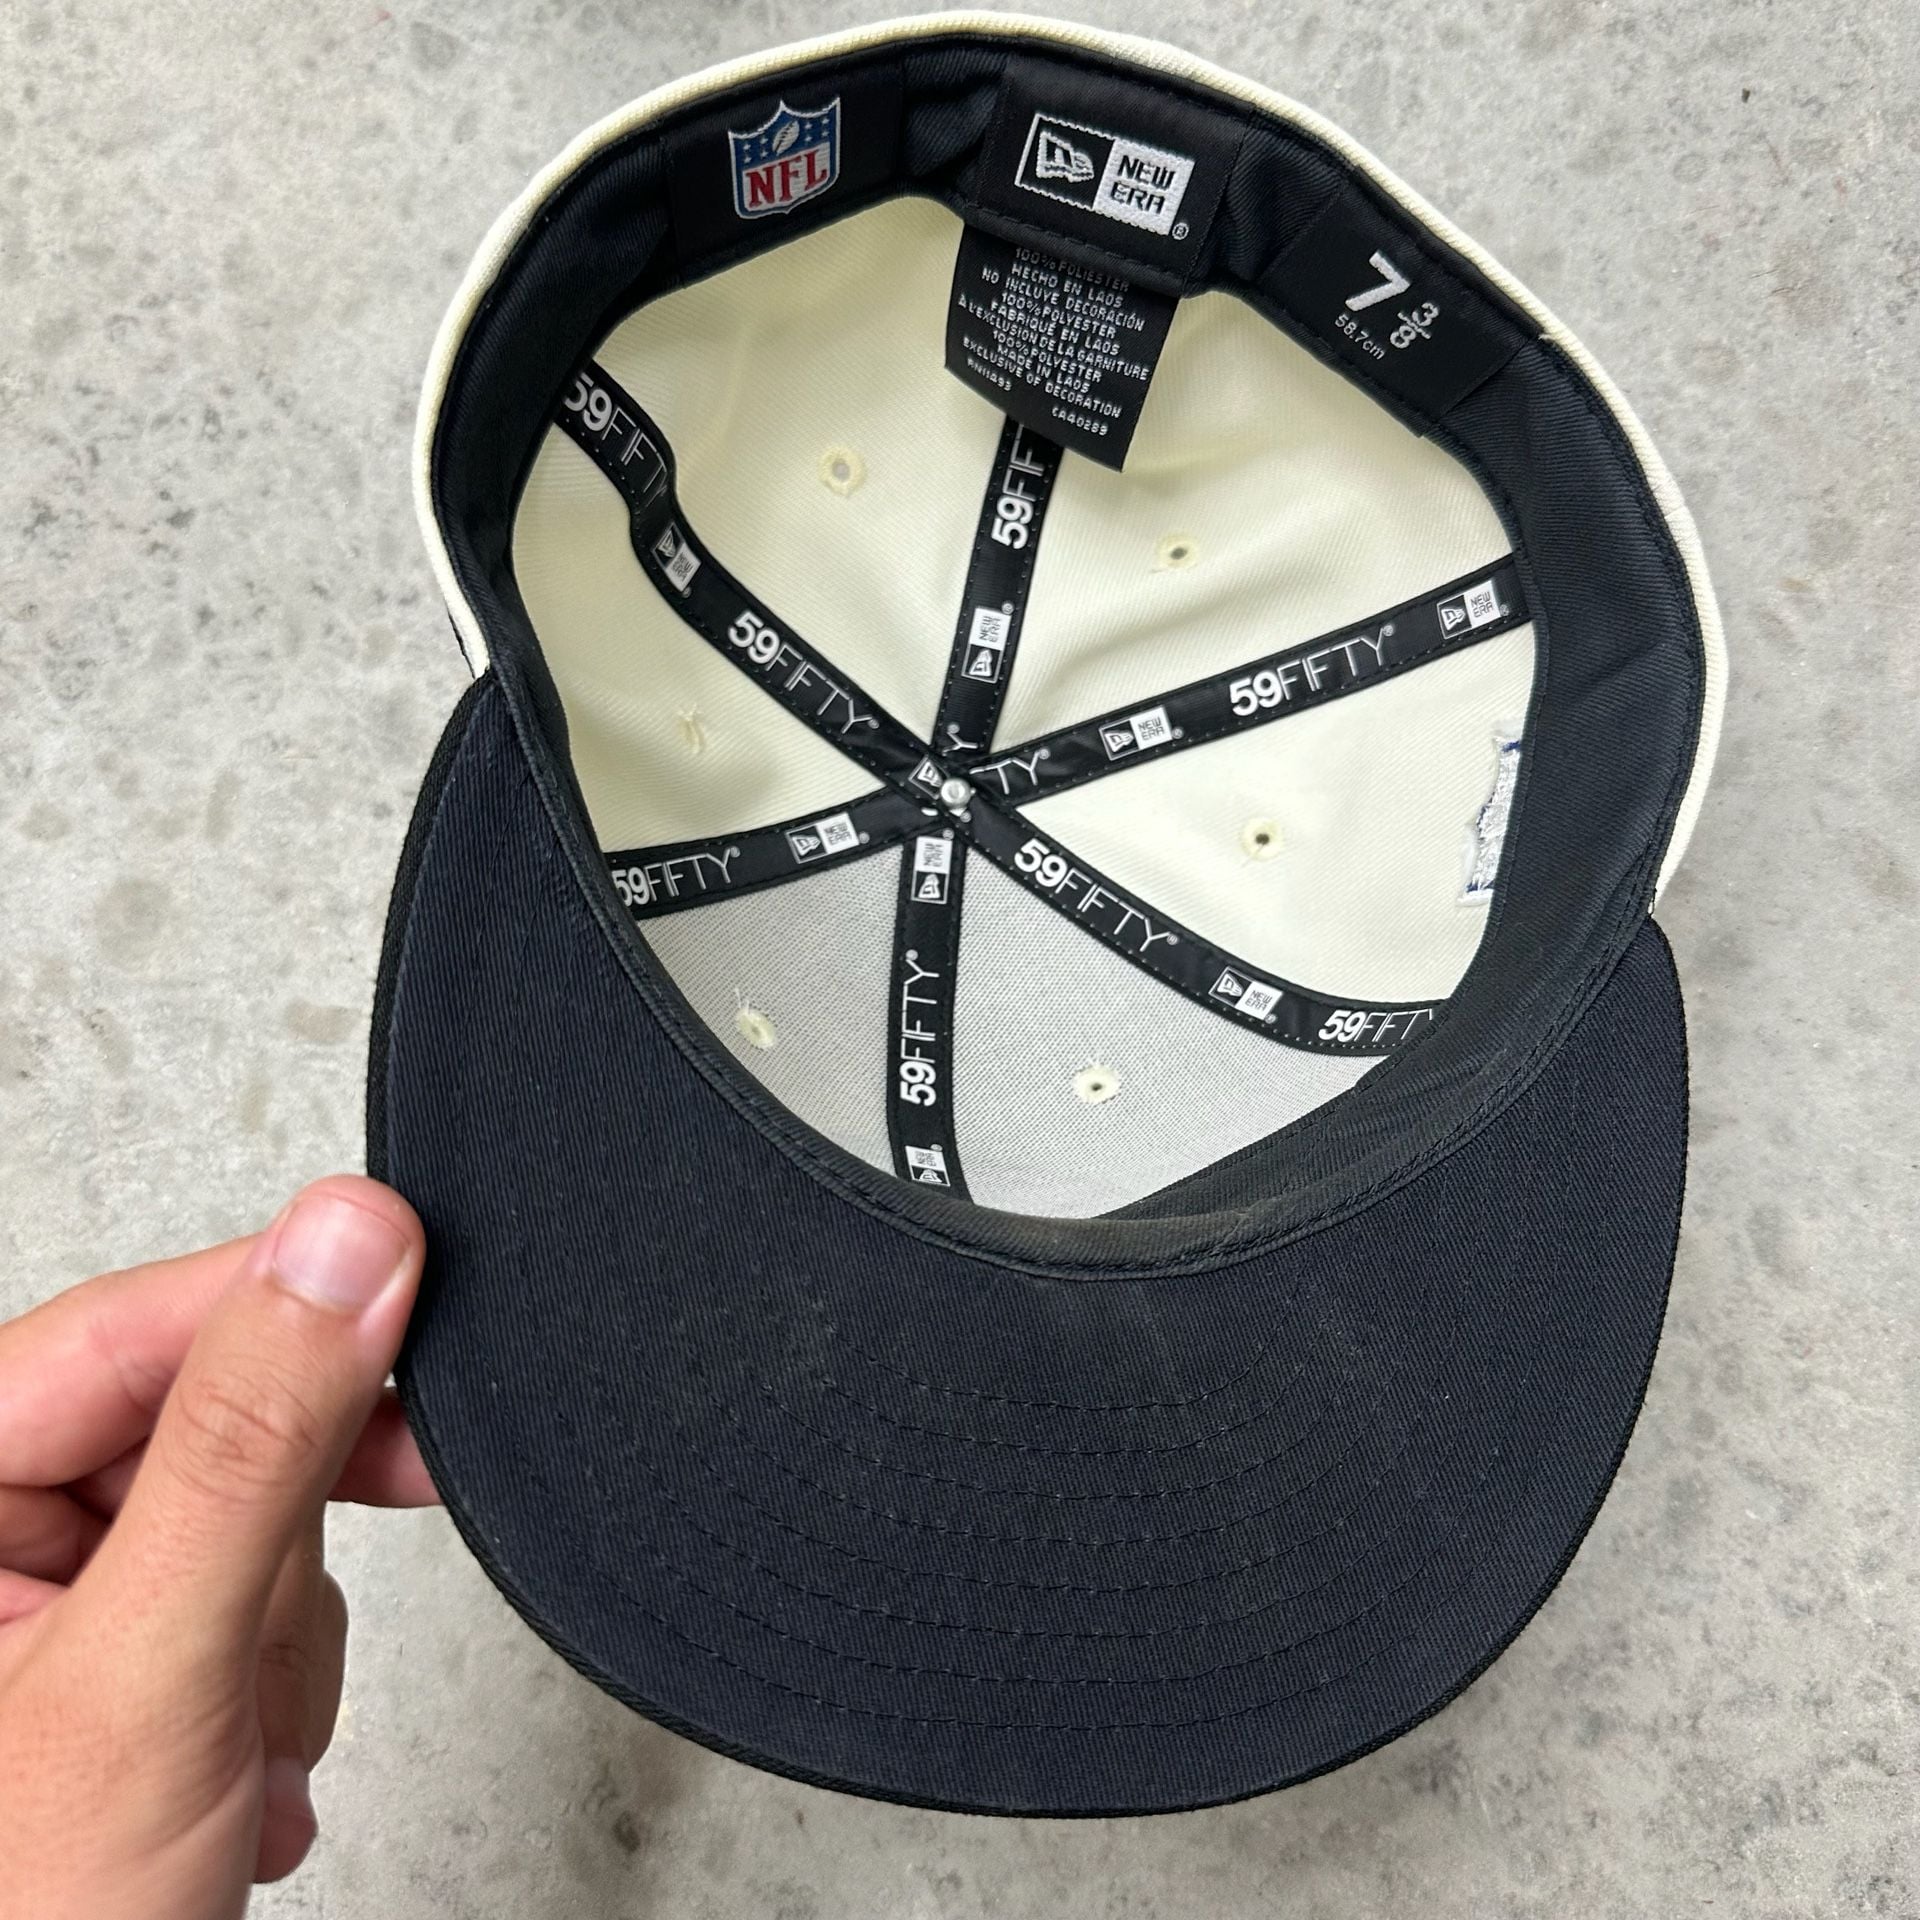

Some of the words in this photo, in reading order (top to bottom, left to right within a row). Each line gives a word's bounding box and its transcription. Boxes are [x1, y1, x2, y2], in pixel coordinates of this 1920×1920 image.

[745, 149, 828, 209] NFL
[1117, 154, 1176, 191] NEW
[1110, 181, 1167, 215] ERA
[1016, 248, 1055, 269] 100%
[1345, 251, 1411, 312] 7
[982, 267, 999, 284] NO
[1005, 277, 1060, 305] INCLUYE
[1065, 297, 1145, 331] DECORACIÓN
[1012, 263, 1058, 288] HECHO
[1063, 280, 1082, 295] EN
[1088, 288, 1123, 308] LAOS
[991, 301, 1056, 336] FABRIQUÉ
[1061, 328, 1079, 343] EN
[1085, 336, 1120, 355] LAOS
[1002, 292, 1041, 316] 100%
[1042, 306, 1116, 339] POLYESTER
[1334, 313, 1385, 360] 58.7cm
[963, 336, 1023, 378] EXCLUSIVE
[1026, 373, 1041, 387] OF
[1045, 382, 1122, 418] DECORATION
[993, 330, 1029, 355] 100%
[1031, 347, 1102, 382] POLYESTER
[998, 344, 1032, 370] MADE
[1036, 364, 1051, 379] IN
[1056, 372, 1090, 393] LAOS
[1039, 337, 1056, 351] DE
[1057, 343, 1075, 358] LA
[1077, 350, 1149, 380] GARNITURE
